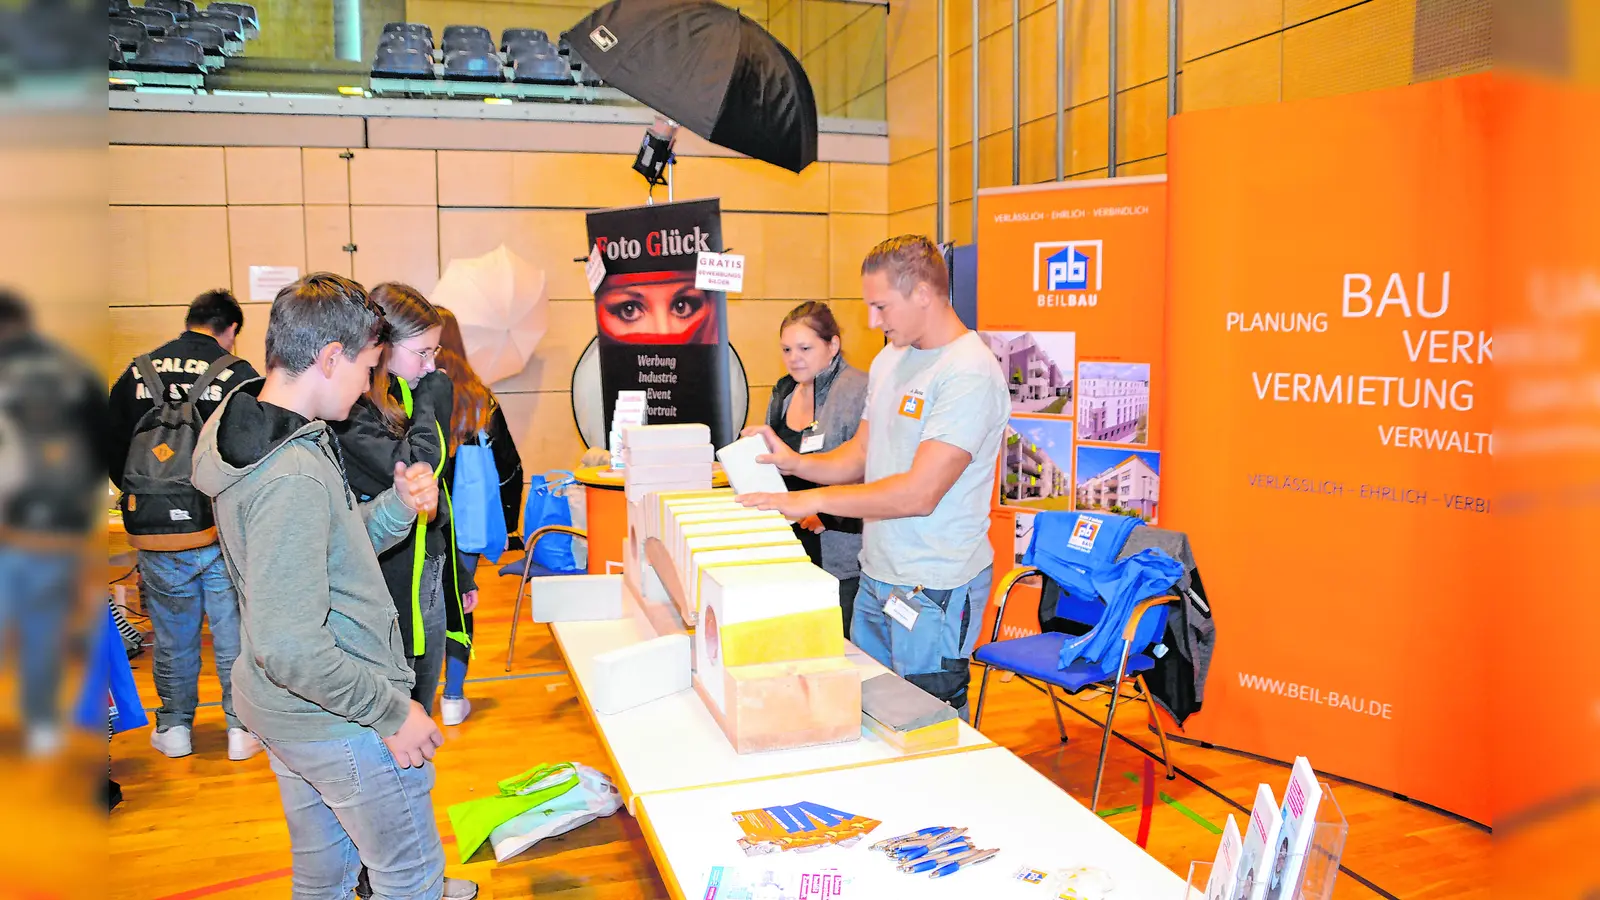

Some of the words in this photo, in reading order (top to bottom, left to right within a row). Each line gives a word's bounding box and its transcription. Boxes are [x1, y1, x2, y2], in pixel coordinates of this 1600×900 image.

[993, 209, 1044, 223] VERLÄSSLICH
[1051, 208, 1085, 220] EHRLICH
[1093, 205, 1149, 218] VERBINDLICH
[595, 236, 642, 261] Foto
[646, 226, 711, 257] Glück
[699, 258, 742, 269] GRATIS
[1037, 294, 1098, 308] BEILBAU
[1341, 271, 1451, 319] BAU
[1225, 312, 1329, 333] PLANUNG
[1402, 329, 1493, 365] VERK
[637, 354, 677, 370] Werbung
[638, 371, 678, 384] Industrie
[647, 387, 672, 401] Event
[1252, 371, 1475, 412] VERMIETUNG
[646, 404, 678, 418] ortrait
[1248, 473, 1343, 496] VERLÄSSLICH
[1360, 483, 1428, 505] EHRLICH
[1237, 671, 1393, 720] WWW.BEIL-BAU.DE
